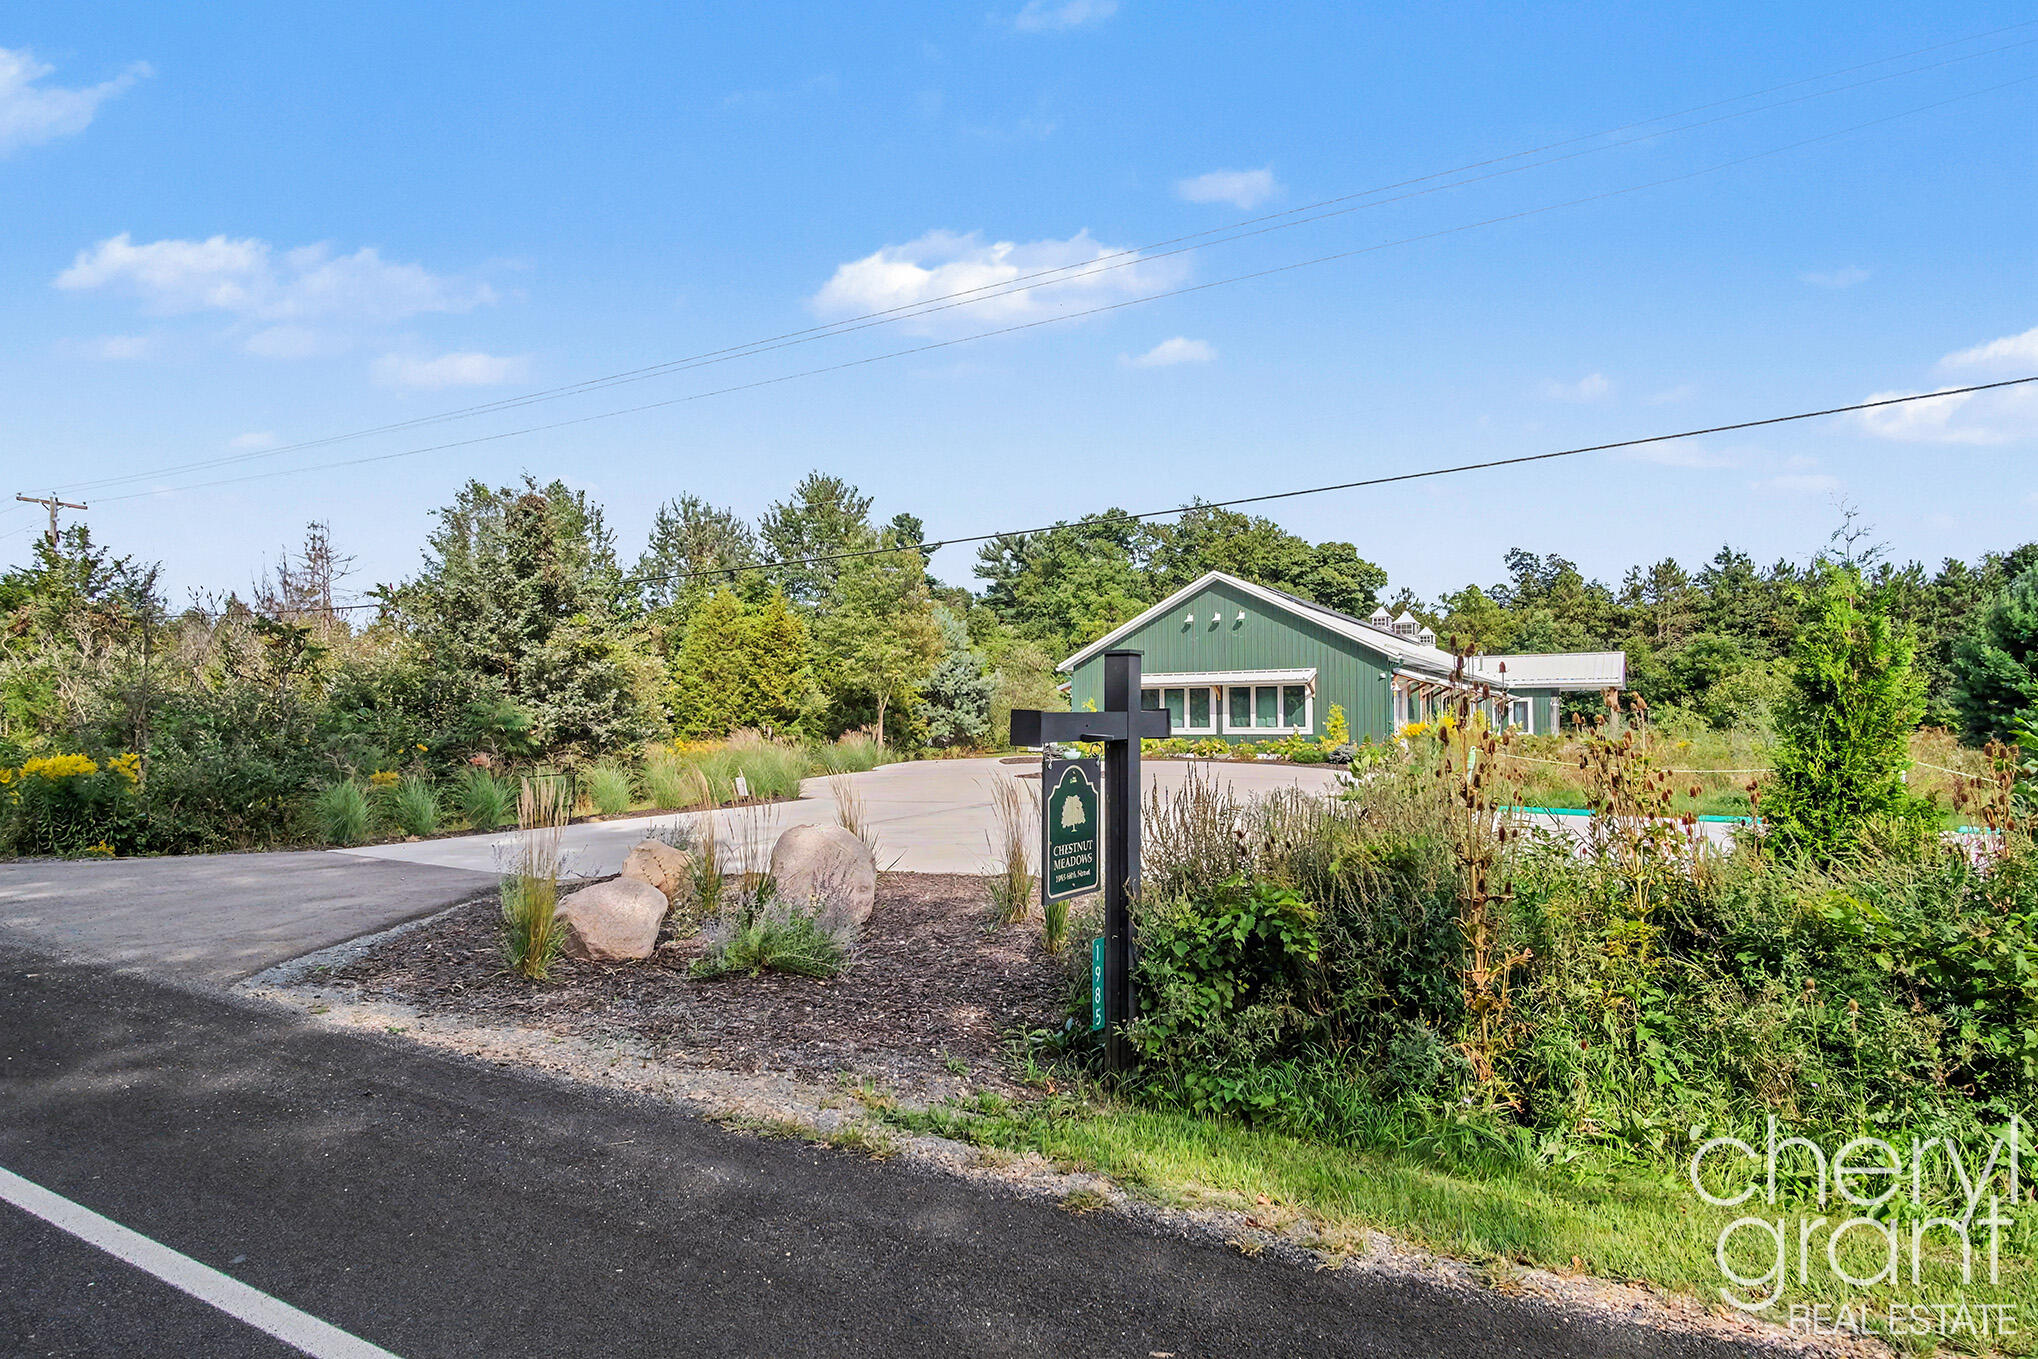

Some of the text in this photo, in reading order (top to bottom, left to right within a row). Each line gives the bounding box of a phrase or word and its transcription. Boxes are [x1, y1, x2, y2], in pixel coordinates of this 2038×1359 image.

[1053, 840, 1093, 857] CHESTNUT
[1053, 852, 1093, 871] MEADOWS
[1094, 944, 1102, 1026] 1985
